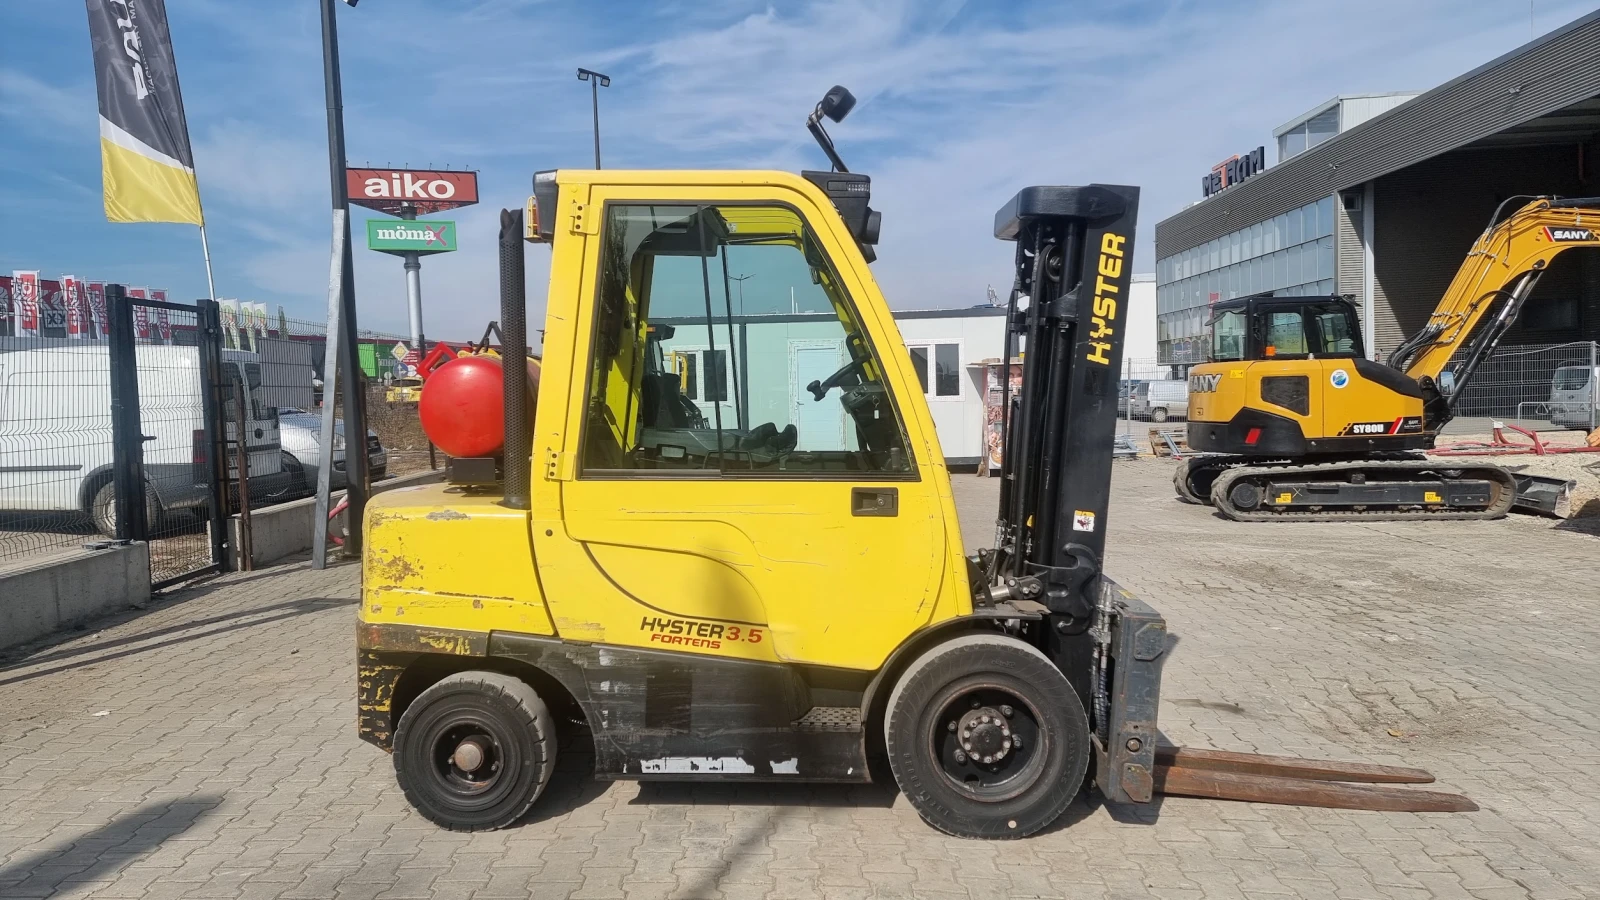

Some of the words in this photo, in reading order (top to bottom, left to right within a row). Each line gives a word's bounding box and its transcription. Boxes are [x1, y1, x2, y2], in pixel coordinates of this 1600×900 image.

[364, 172, 456, 199] aiko
[1553, 230, 1589, 240] SANY
[1086, 232, 1126, 365] HYSTER
[1352, 423, 1385, 434] SY80U
[640, 616, 725, 640] HYSTER
[725, 625, 764, 644] 3.5
[650, 633, 722, 650] FORTENS
